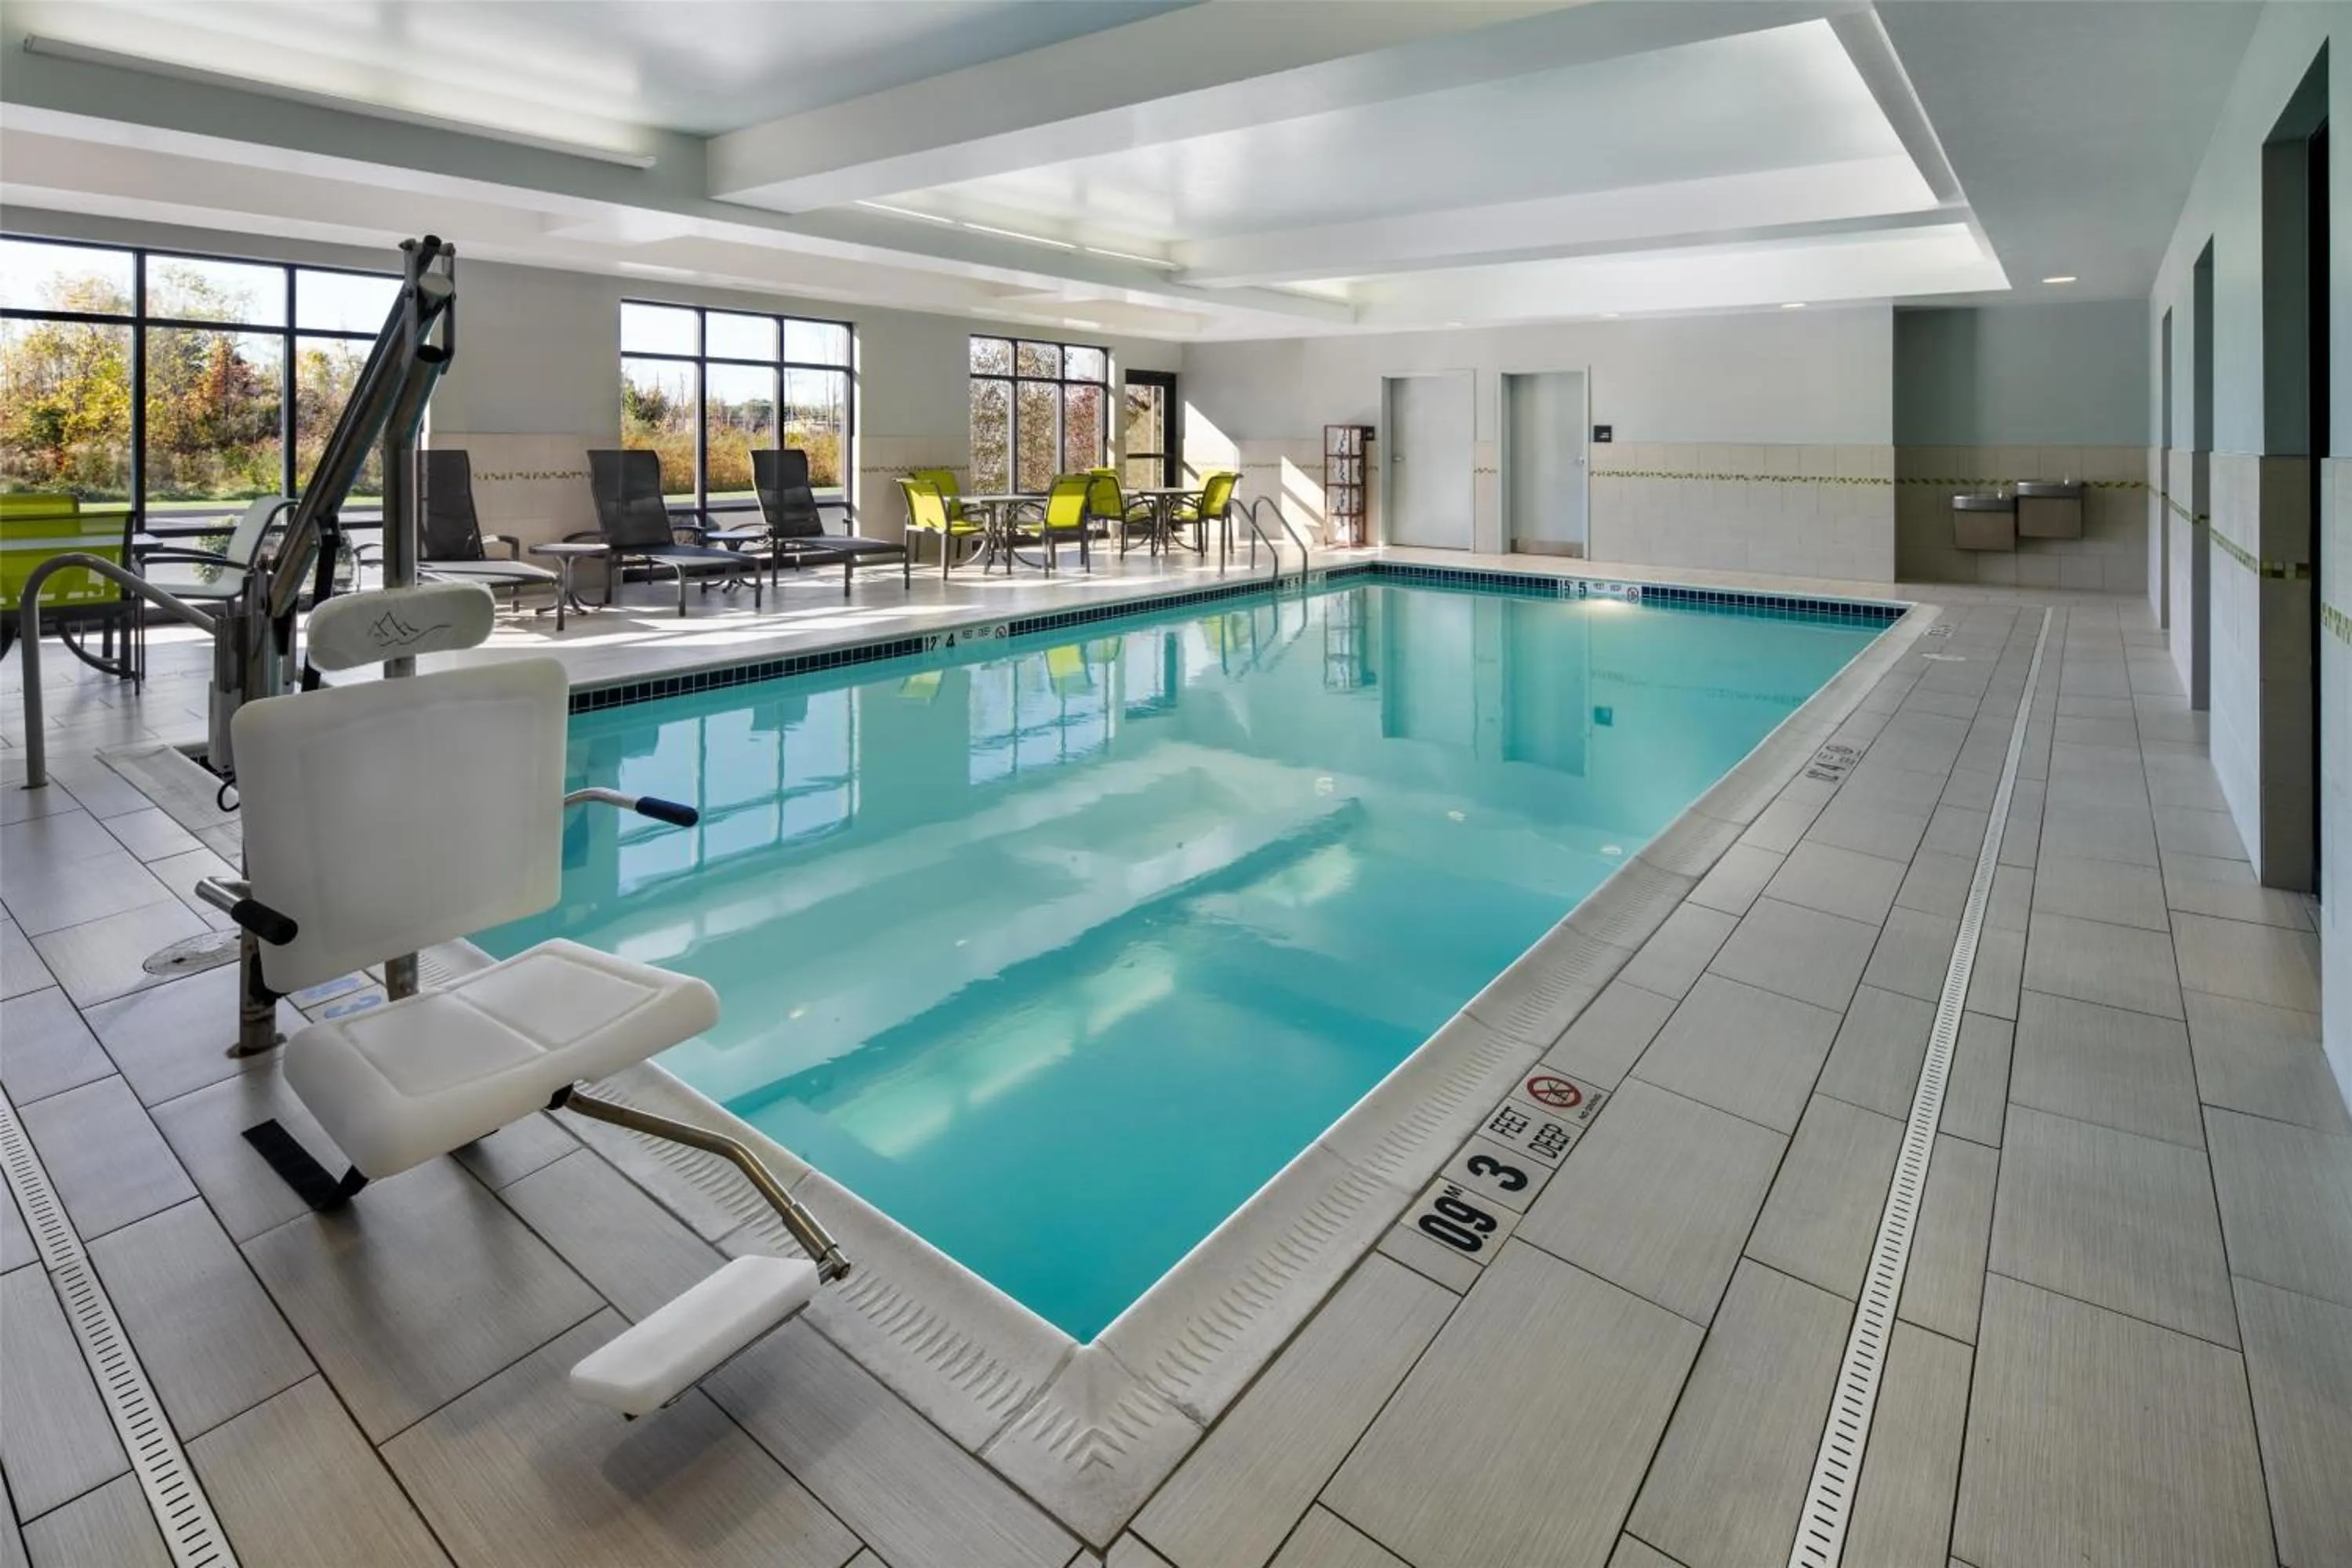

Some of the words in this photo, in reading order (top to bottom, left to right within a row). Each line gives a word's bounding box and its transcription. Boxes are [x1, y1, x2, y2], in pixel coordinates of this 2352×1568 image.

[1489, 1105, 1531, 1140] FEET
[1527, 1123, 1572, 1160] DEEP
[1467, 1154, 1529, 1192] 3
